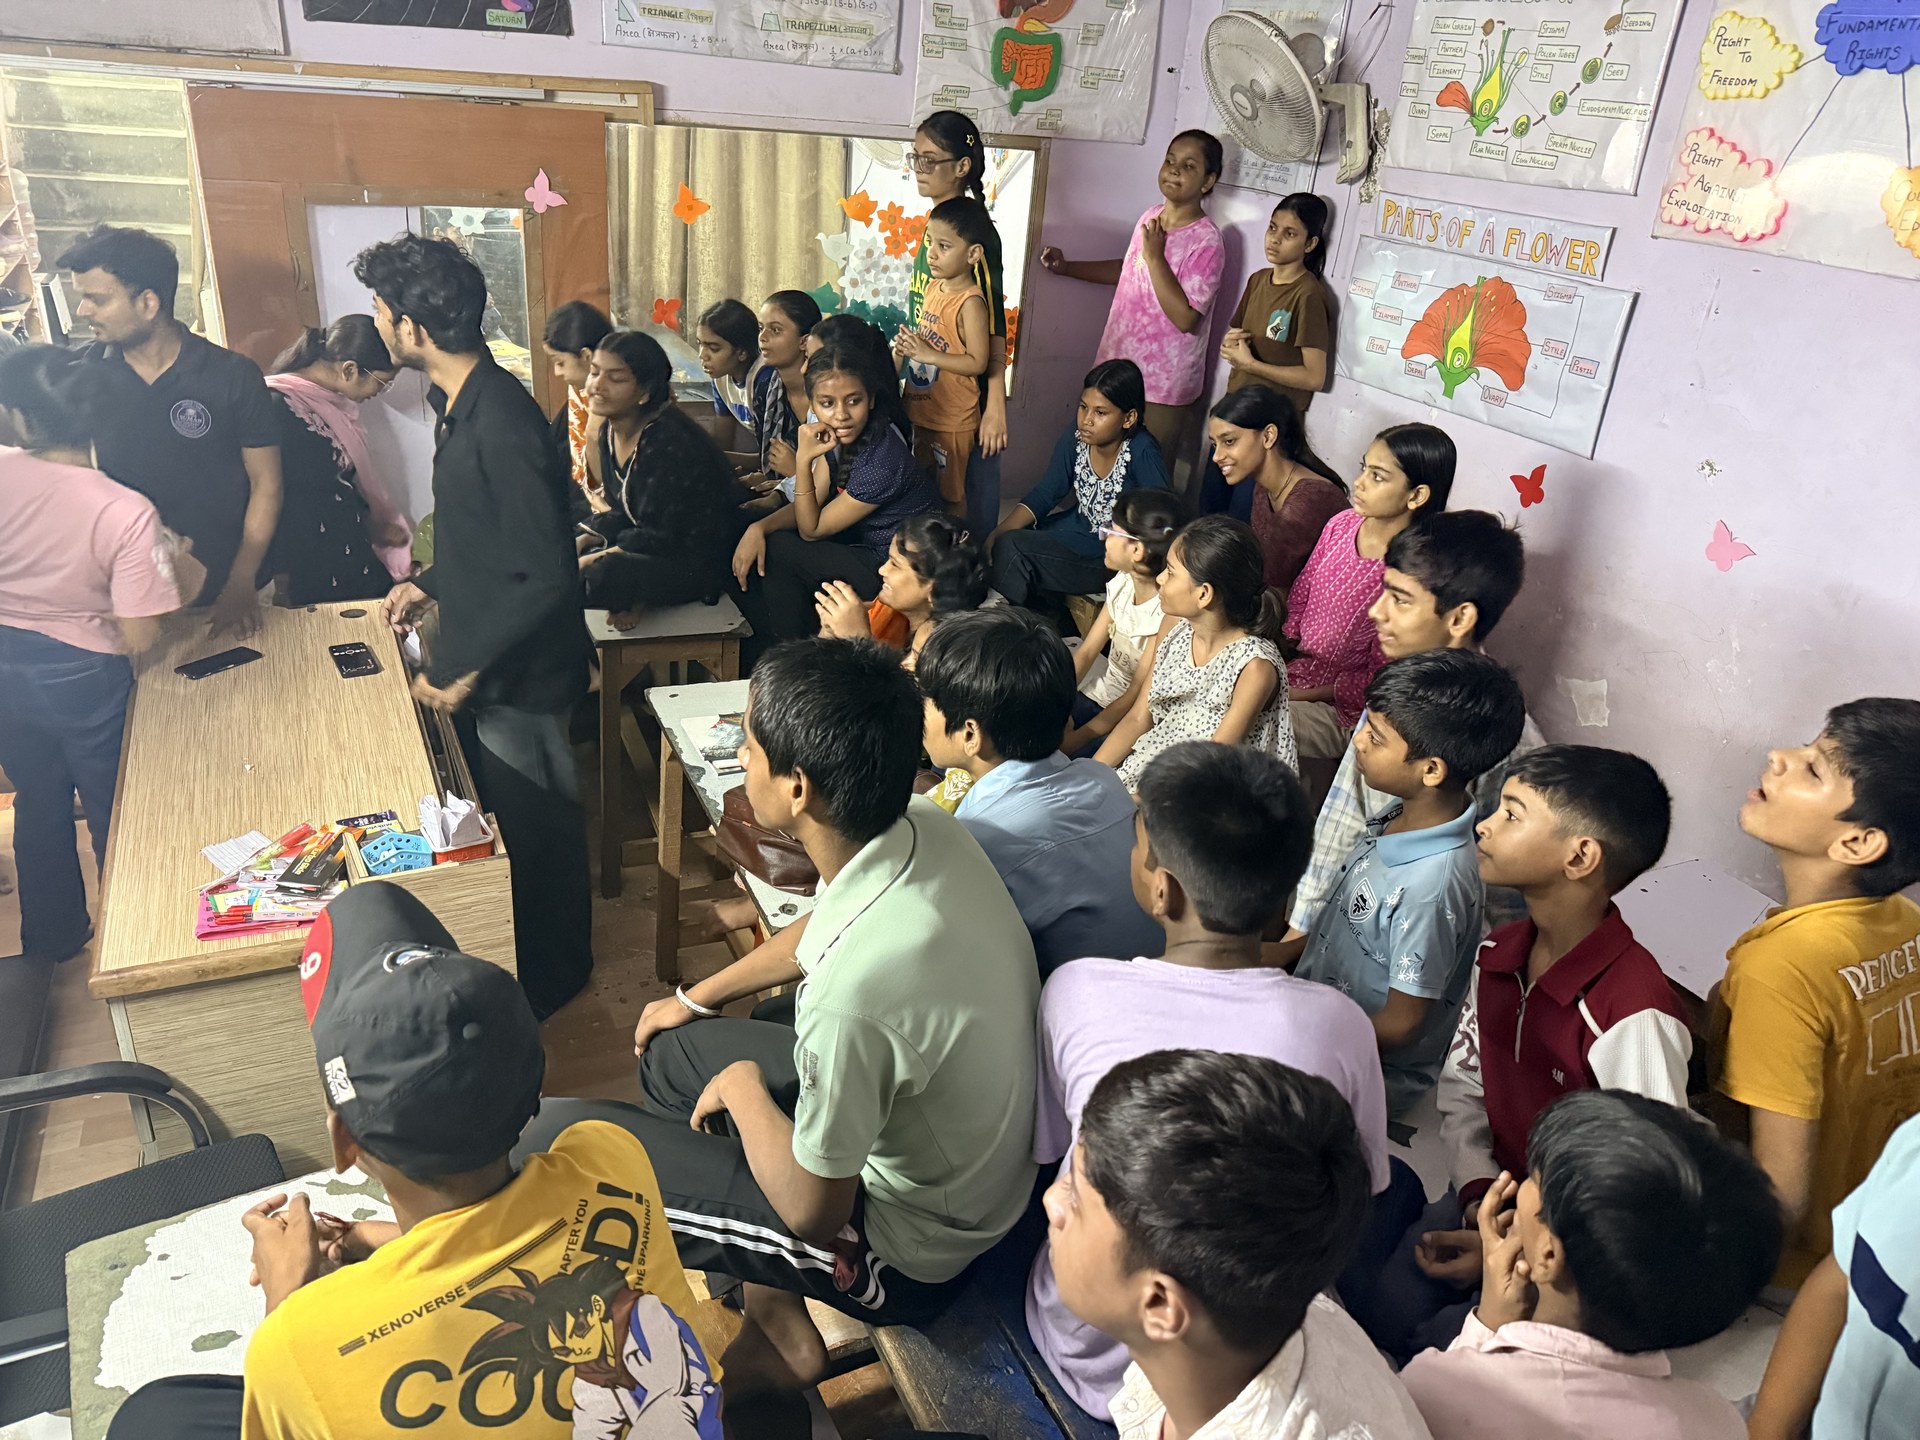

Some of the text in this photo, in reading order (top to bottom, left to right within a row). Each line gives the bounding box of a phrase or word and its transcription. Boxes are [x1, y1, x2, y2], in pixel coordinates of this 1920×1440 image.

[488, 11, 523, 25] SATURN
[641, 7, 684, 20] TRIANGLE
[785, 20, 838, 32] TRAPEZIUM
[1713, 26, 1751, 54] RIGHT
[1537, 47, 1576, 59] POLLEN TUBES
[1845, 40, 1902, 70] RIGHTS
[1432, 64, 1461, 76] FILAMENT
[1606, 65, 1624, 77] SEED
[1709, 70, 1758, 87] FREEDOM
[1548, 136, 1569, 148] SPERM
[1688, 143, 1724, 168] RIGHT
[1667, 189, 1743, 224] EXPLOITATION
[1381, 199, 1600, 276] PARTS OF A FLOWER
[1352, 279, 1373, 296] STAMEN
[1394, 272, 1418, 290] ANTHER
[1547, 286, 1573, 301] STIGMA
[1375, 305, 1400, 322] FILAMENT
[1369, 339, 1385, 352] PETAL
[1544, 341, 1565, 356] STYLE
[1407, 362, 1424, 376] SEPAL
[1484, 388, 1504, 406] OVARY
[573, 1199, 589, 1226] YOU
[638, 1198, 651, 1266] SPARKING
[367, 1285, 467, 1343] XENOVERSE
